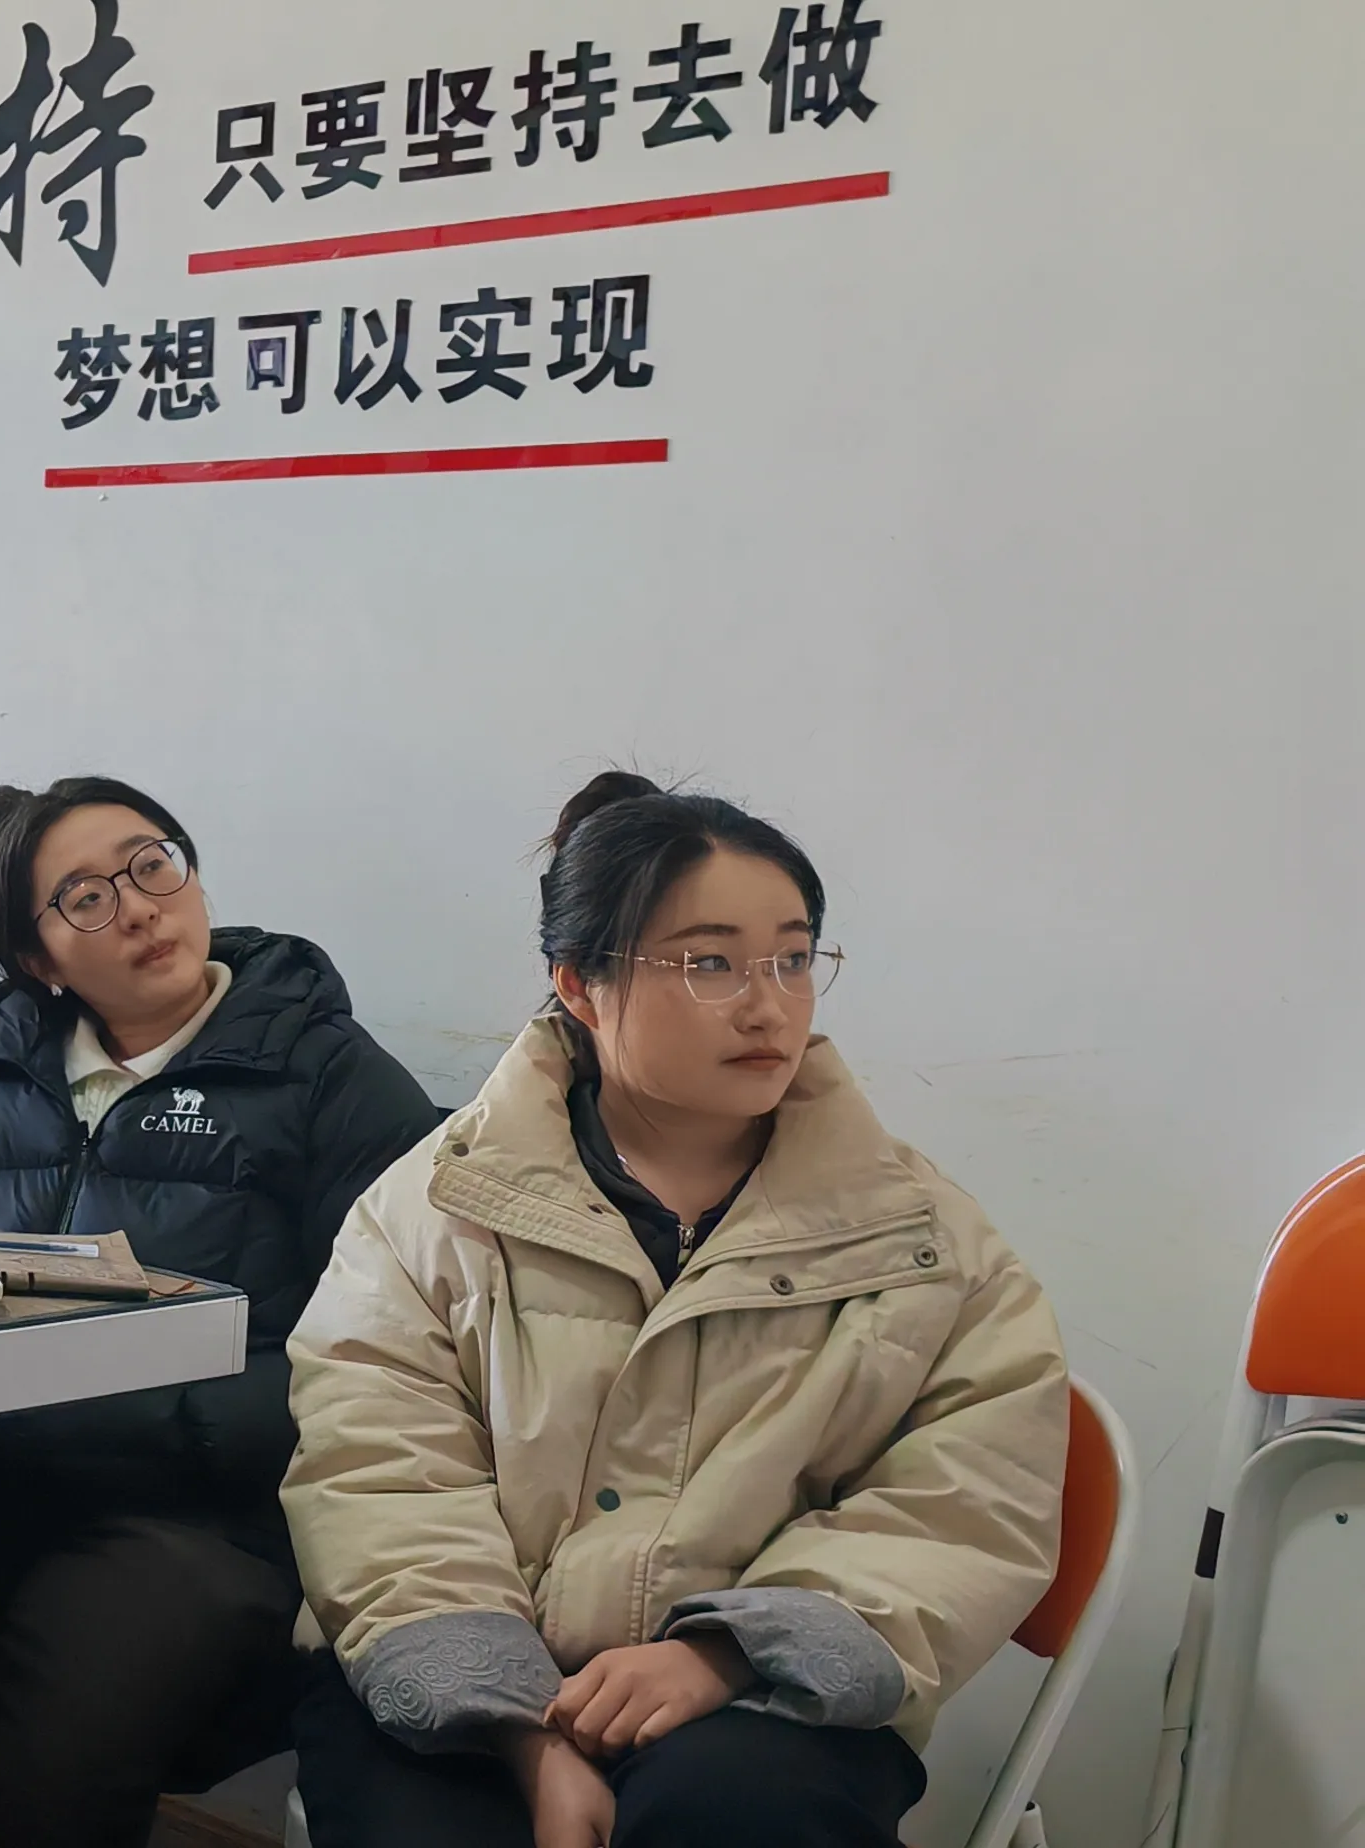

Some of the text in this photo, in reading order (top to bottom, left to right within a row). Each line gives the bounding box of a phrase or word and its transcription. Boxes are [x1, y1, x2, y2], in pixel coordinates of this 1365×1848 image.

[203, 0, 883, 210] 只要坚持去做
[54, 274, 654, 431] 梦想可以实现
[140, 1115, 218, 1134] CAMEL
